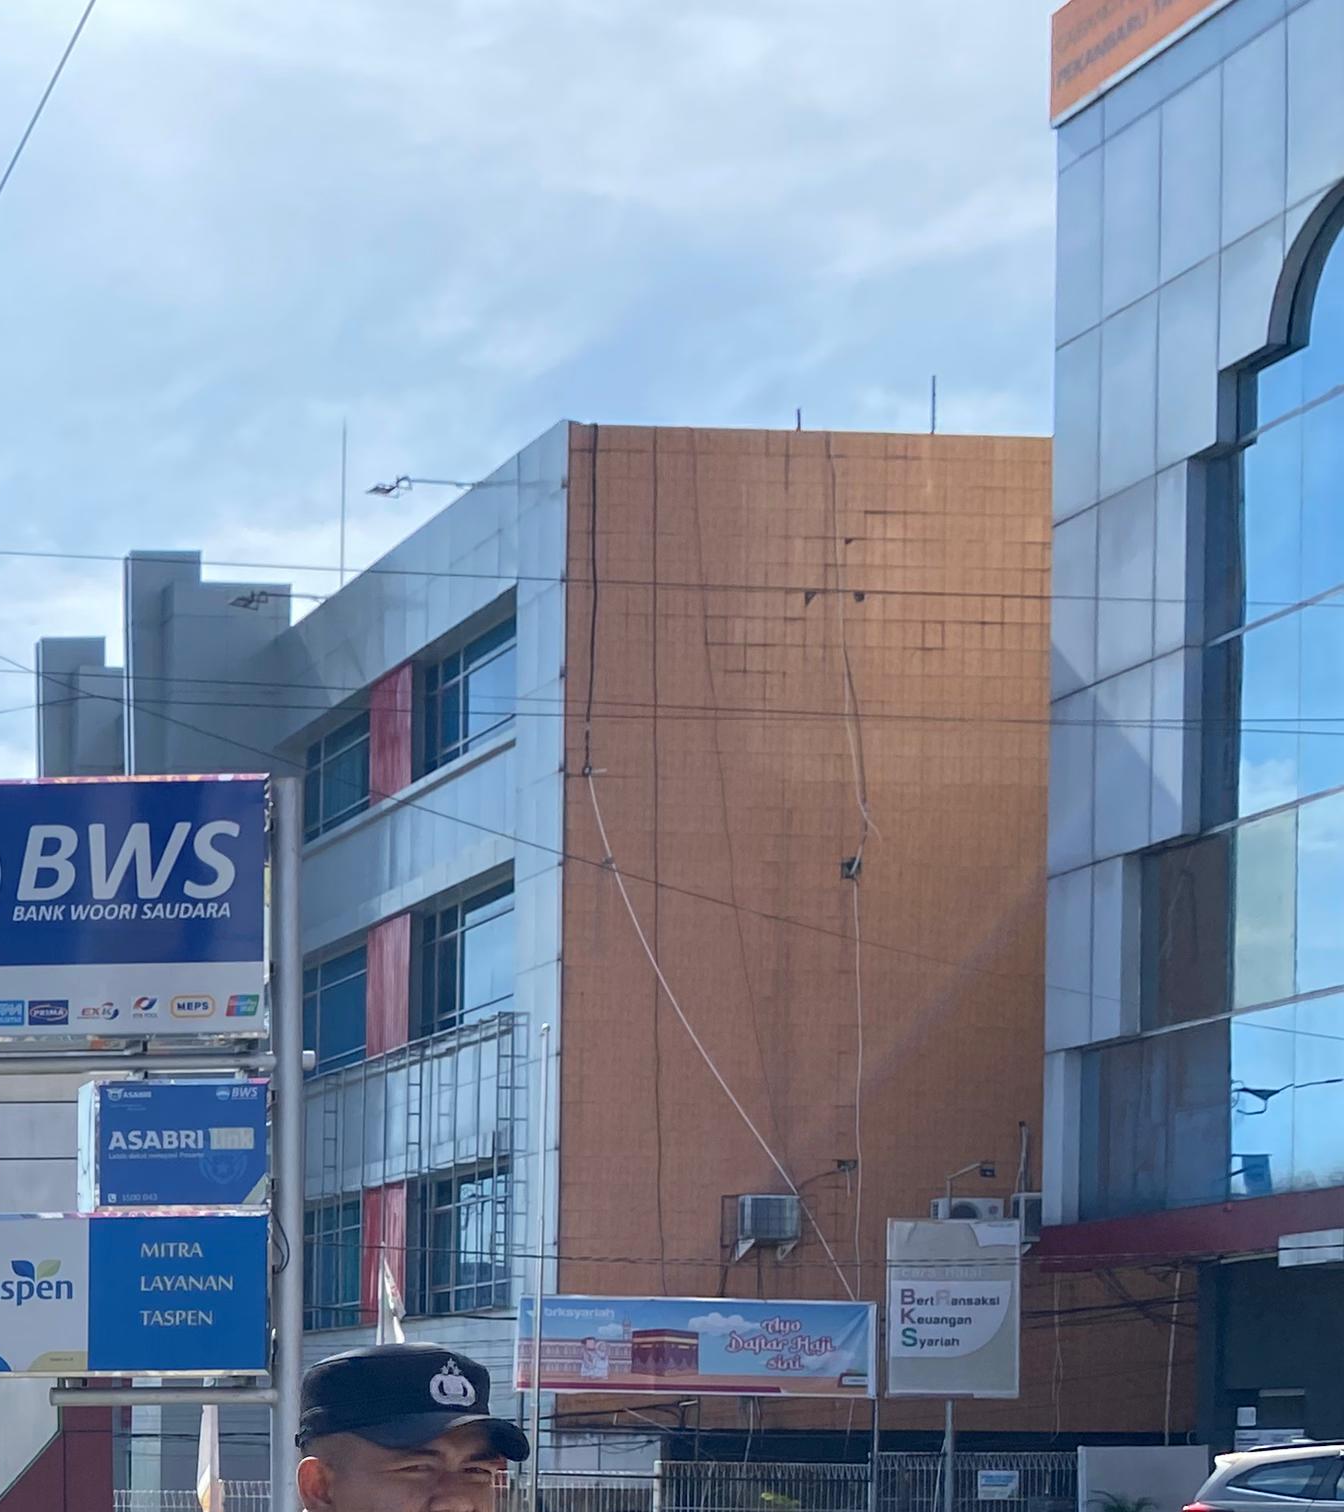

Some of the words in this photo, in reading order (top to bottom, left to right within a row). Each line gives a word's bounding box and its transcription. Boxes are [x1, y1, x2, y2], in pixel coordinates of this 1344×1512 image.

[16, 820, 241, 901] BWS
[12, 904, 64, 921] BANK
[70, 903, 137, 921] WOORI
[142, 901, 231, 920] SAUDARA
[33, 1008, 64, 1017] PRIMA
[176, 1001, 209, 1011] MEPS
[231, 1087, 258, 1097] BWS
[108, 1130, 204, 1150] ASABRI
[140, 1242, 204, 1258] MITRA
[140, 1275, 234, 1292] LAYANAN
[139, 1309, 213, 1326] TASPEN
[760, 1315, 802, 1337] Ayo
[900, 1308, 972, 1328] Keuangan
[725, 1330, 788, 1355] Daftar
[789, 1335, 837, 1356] Haji
[901, 1327, 960, 1349] Syariah
[766, 1354, 804, 1371] sini
